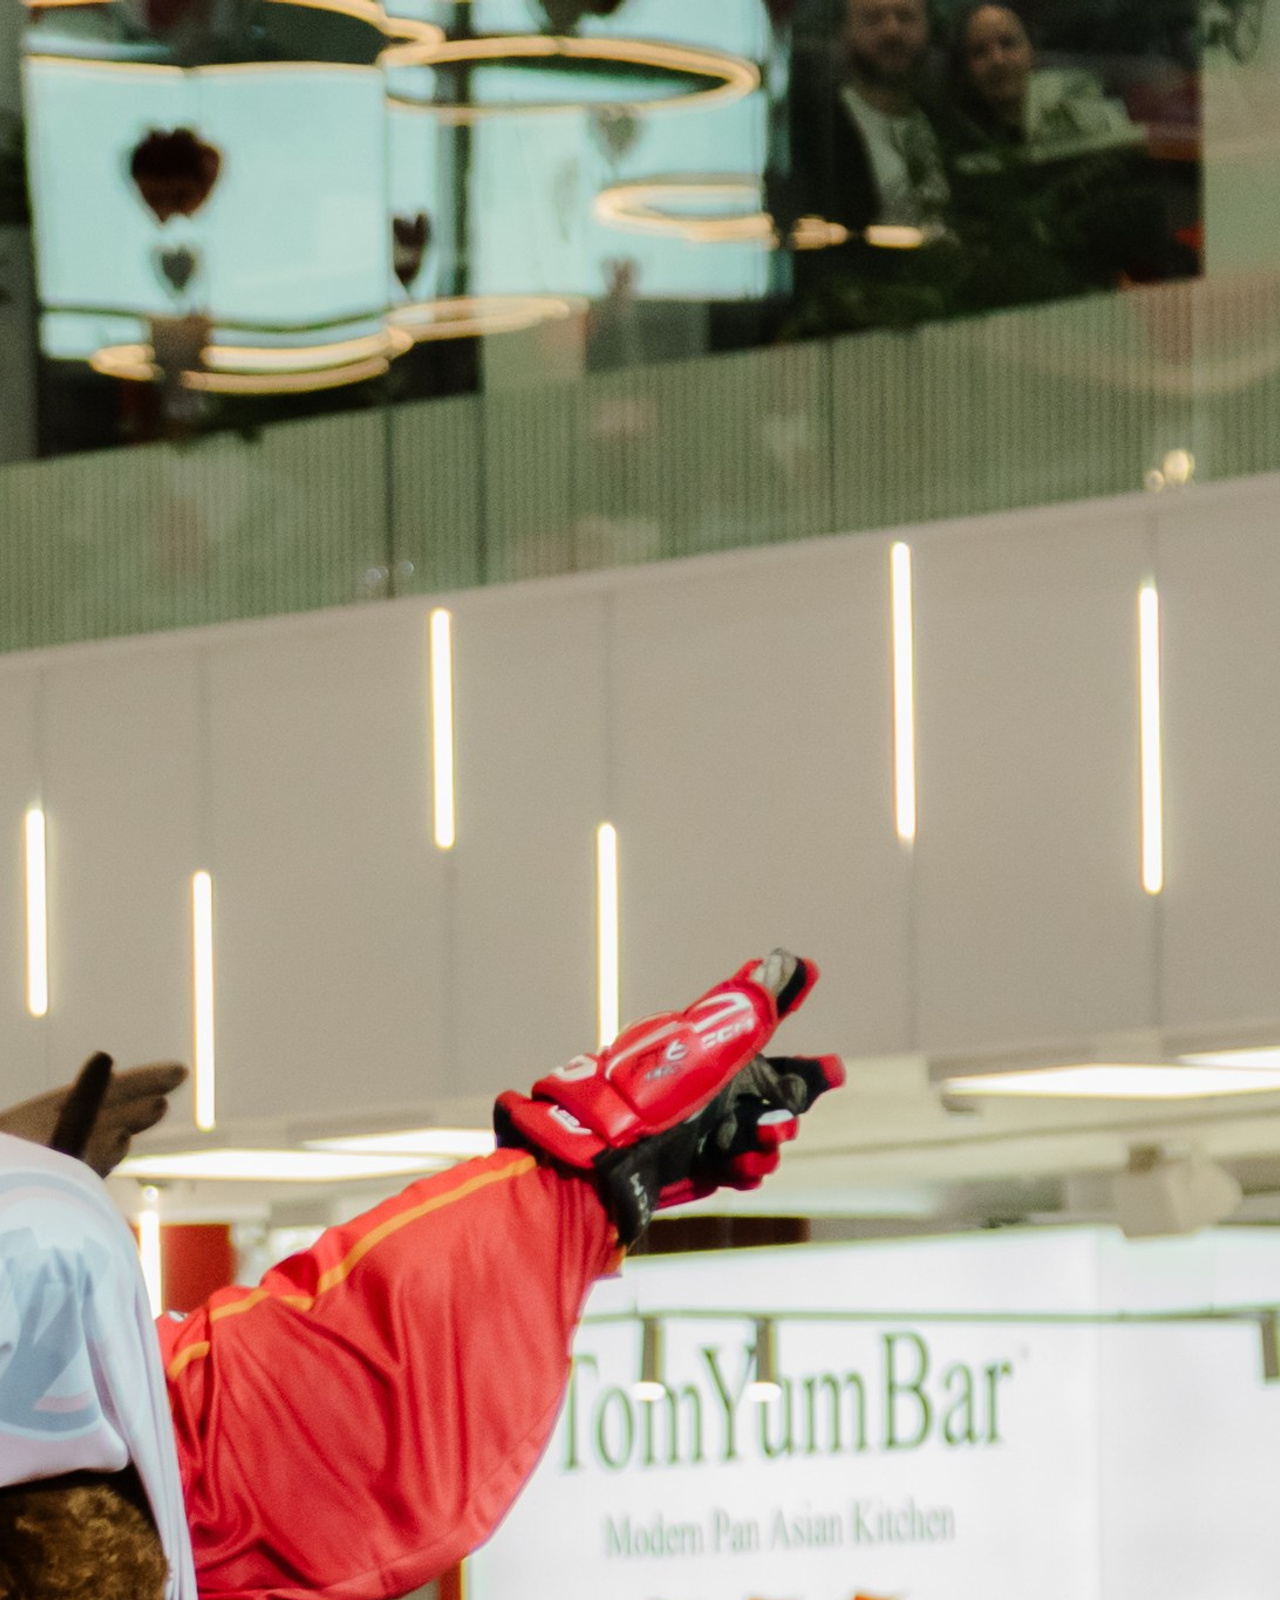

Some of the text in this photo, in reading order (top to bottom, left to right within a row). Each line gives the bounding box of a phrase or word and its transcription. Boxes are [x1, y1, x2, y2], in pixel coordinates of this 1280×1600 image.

[561, 1331, 1013, 1471] TomYumBar
[603, 1495, 955, 1557] Modern Pan Asian Kitchen
